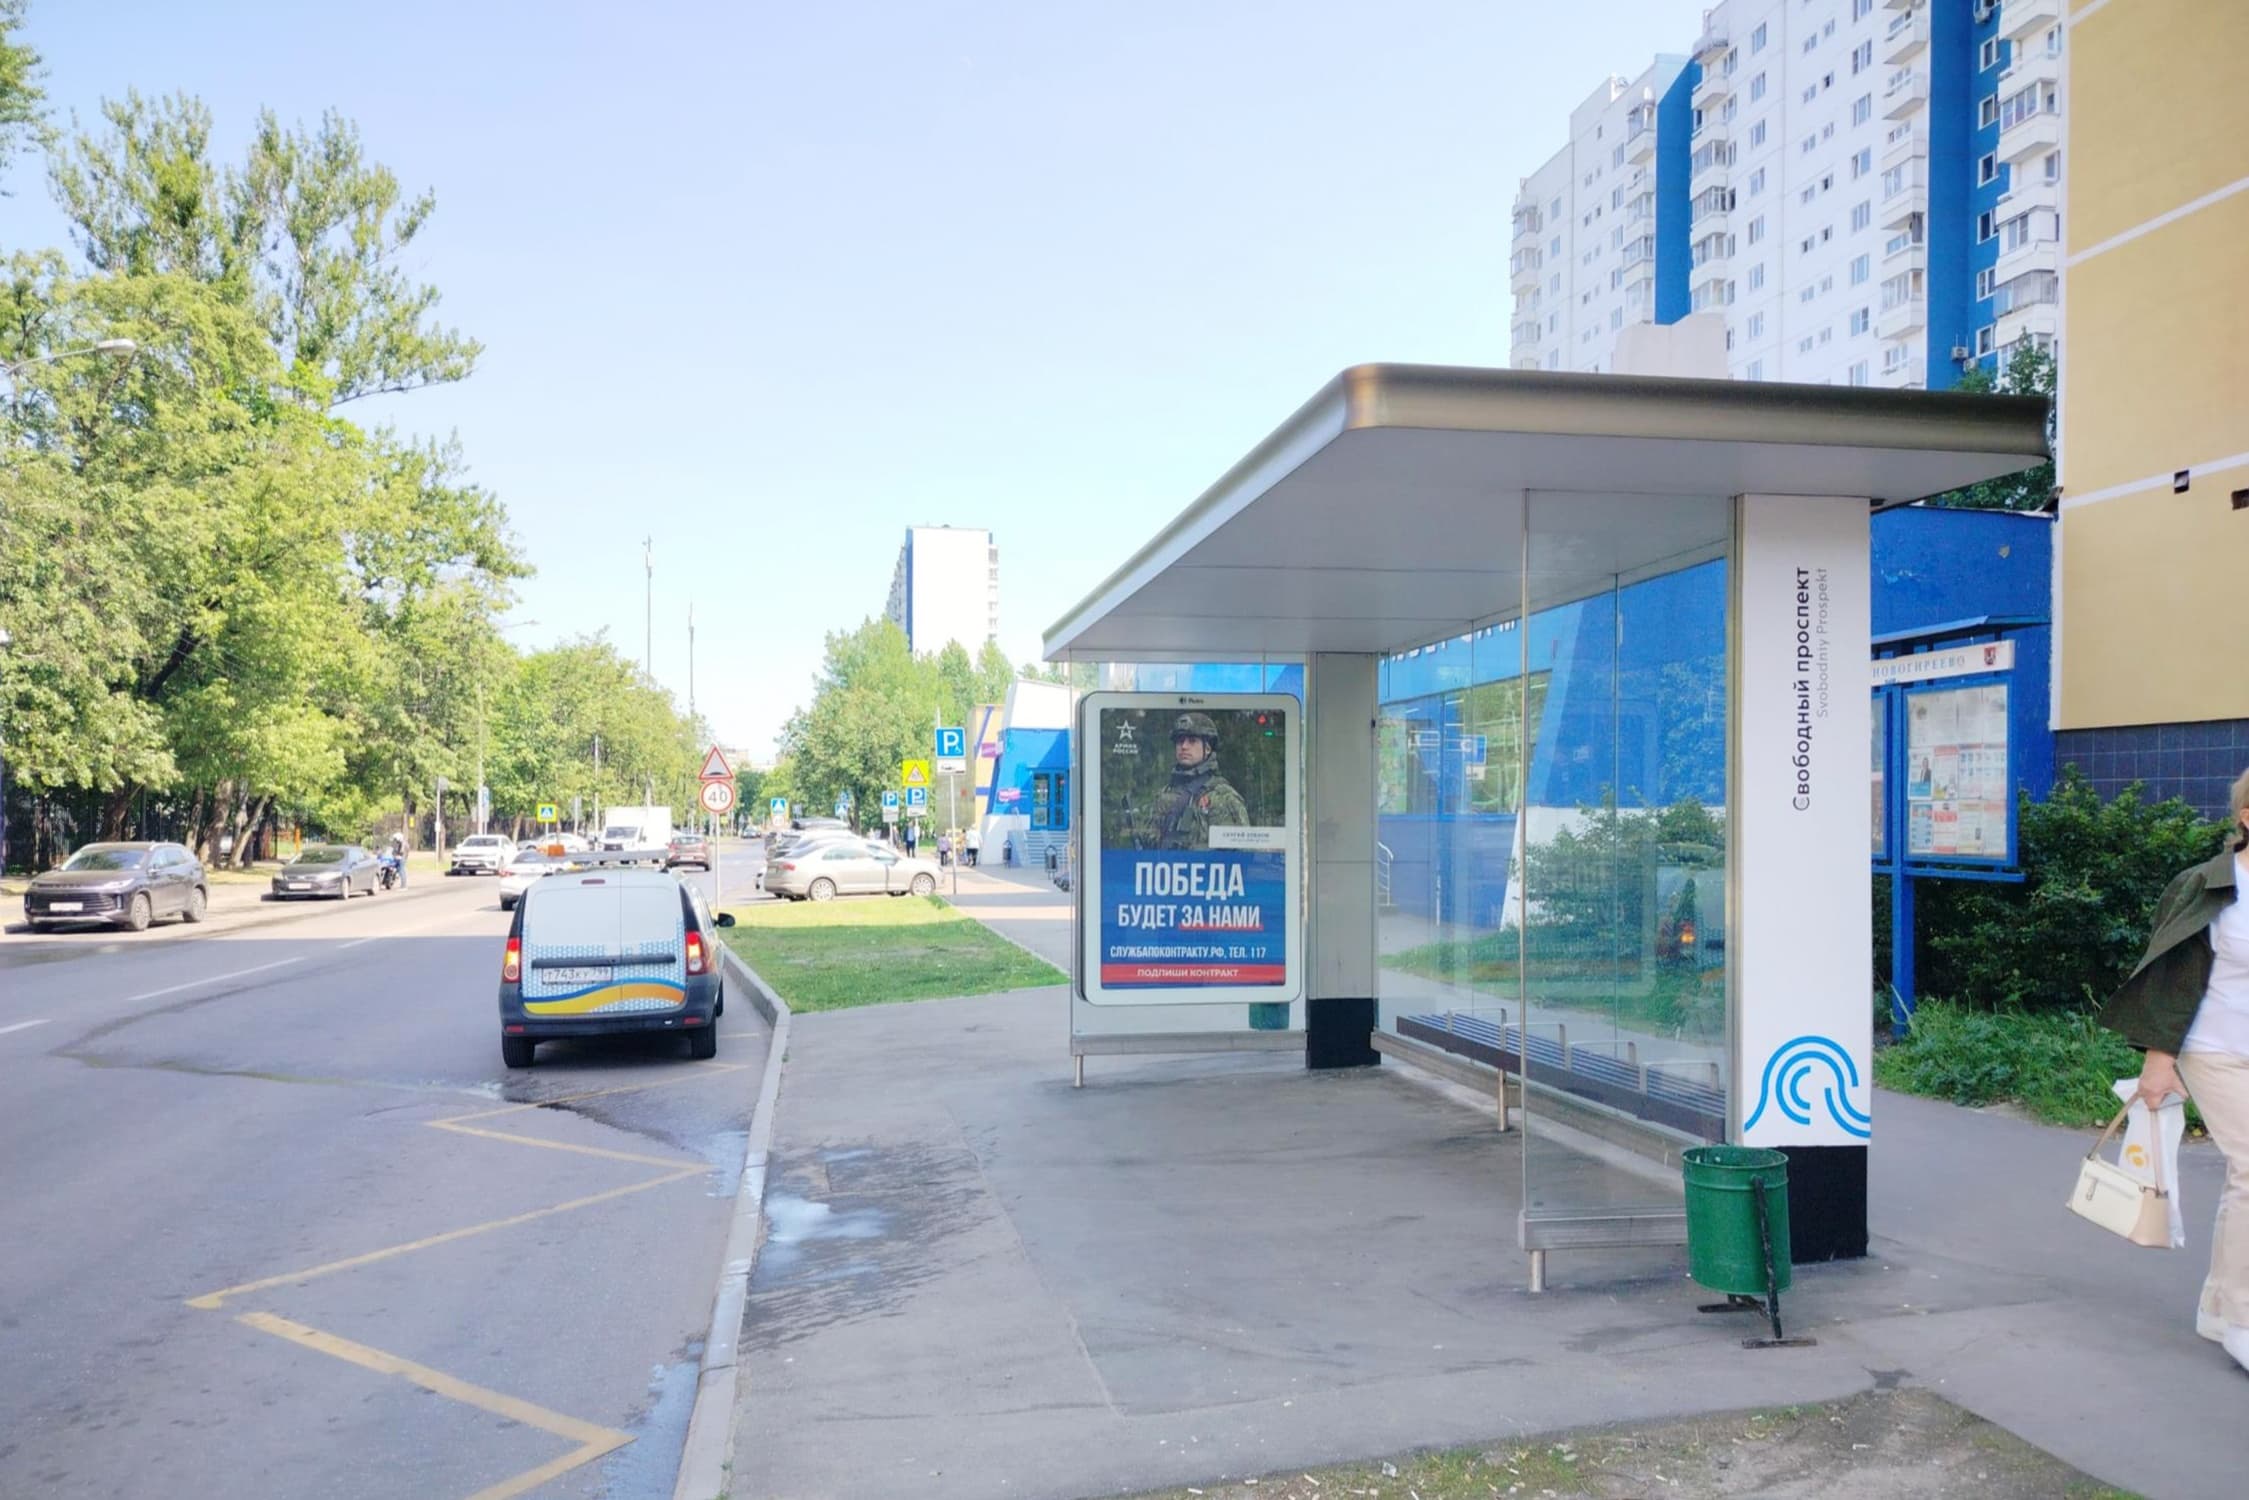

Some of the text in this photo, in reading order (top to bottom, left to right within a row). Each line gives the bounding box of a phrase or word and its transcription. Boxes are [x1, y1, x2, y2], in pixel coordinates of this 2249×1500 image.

[1815, 567, 1830, 719] Svobodniy Prospekt
[1872, 656, 1966, 678] НОВОГИРЕЕВО
[1792, 566, 1814, 811] Свободный проспект
[943, 731, 960, 755] P
[708, 789, 729, 803] 40
[1135, 861, 1245, 901] ПОБЕДА
[1118, 904, 1261, 930] БУДЕТ ЗА НАМИ
[1229, 946, 1248, 959] ТЕЛ.
[1251, 947, 1267, 959] 117
[1137, 968, 1240, 978] ПОДПИШИ КОНТРАКТ
